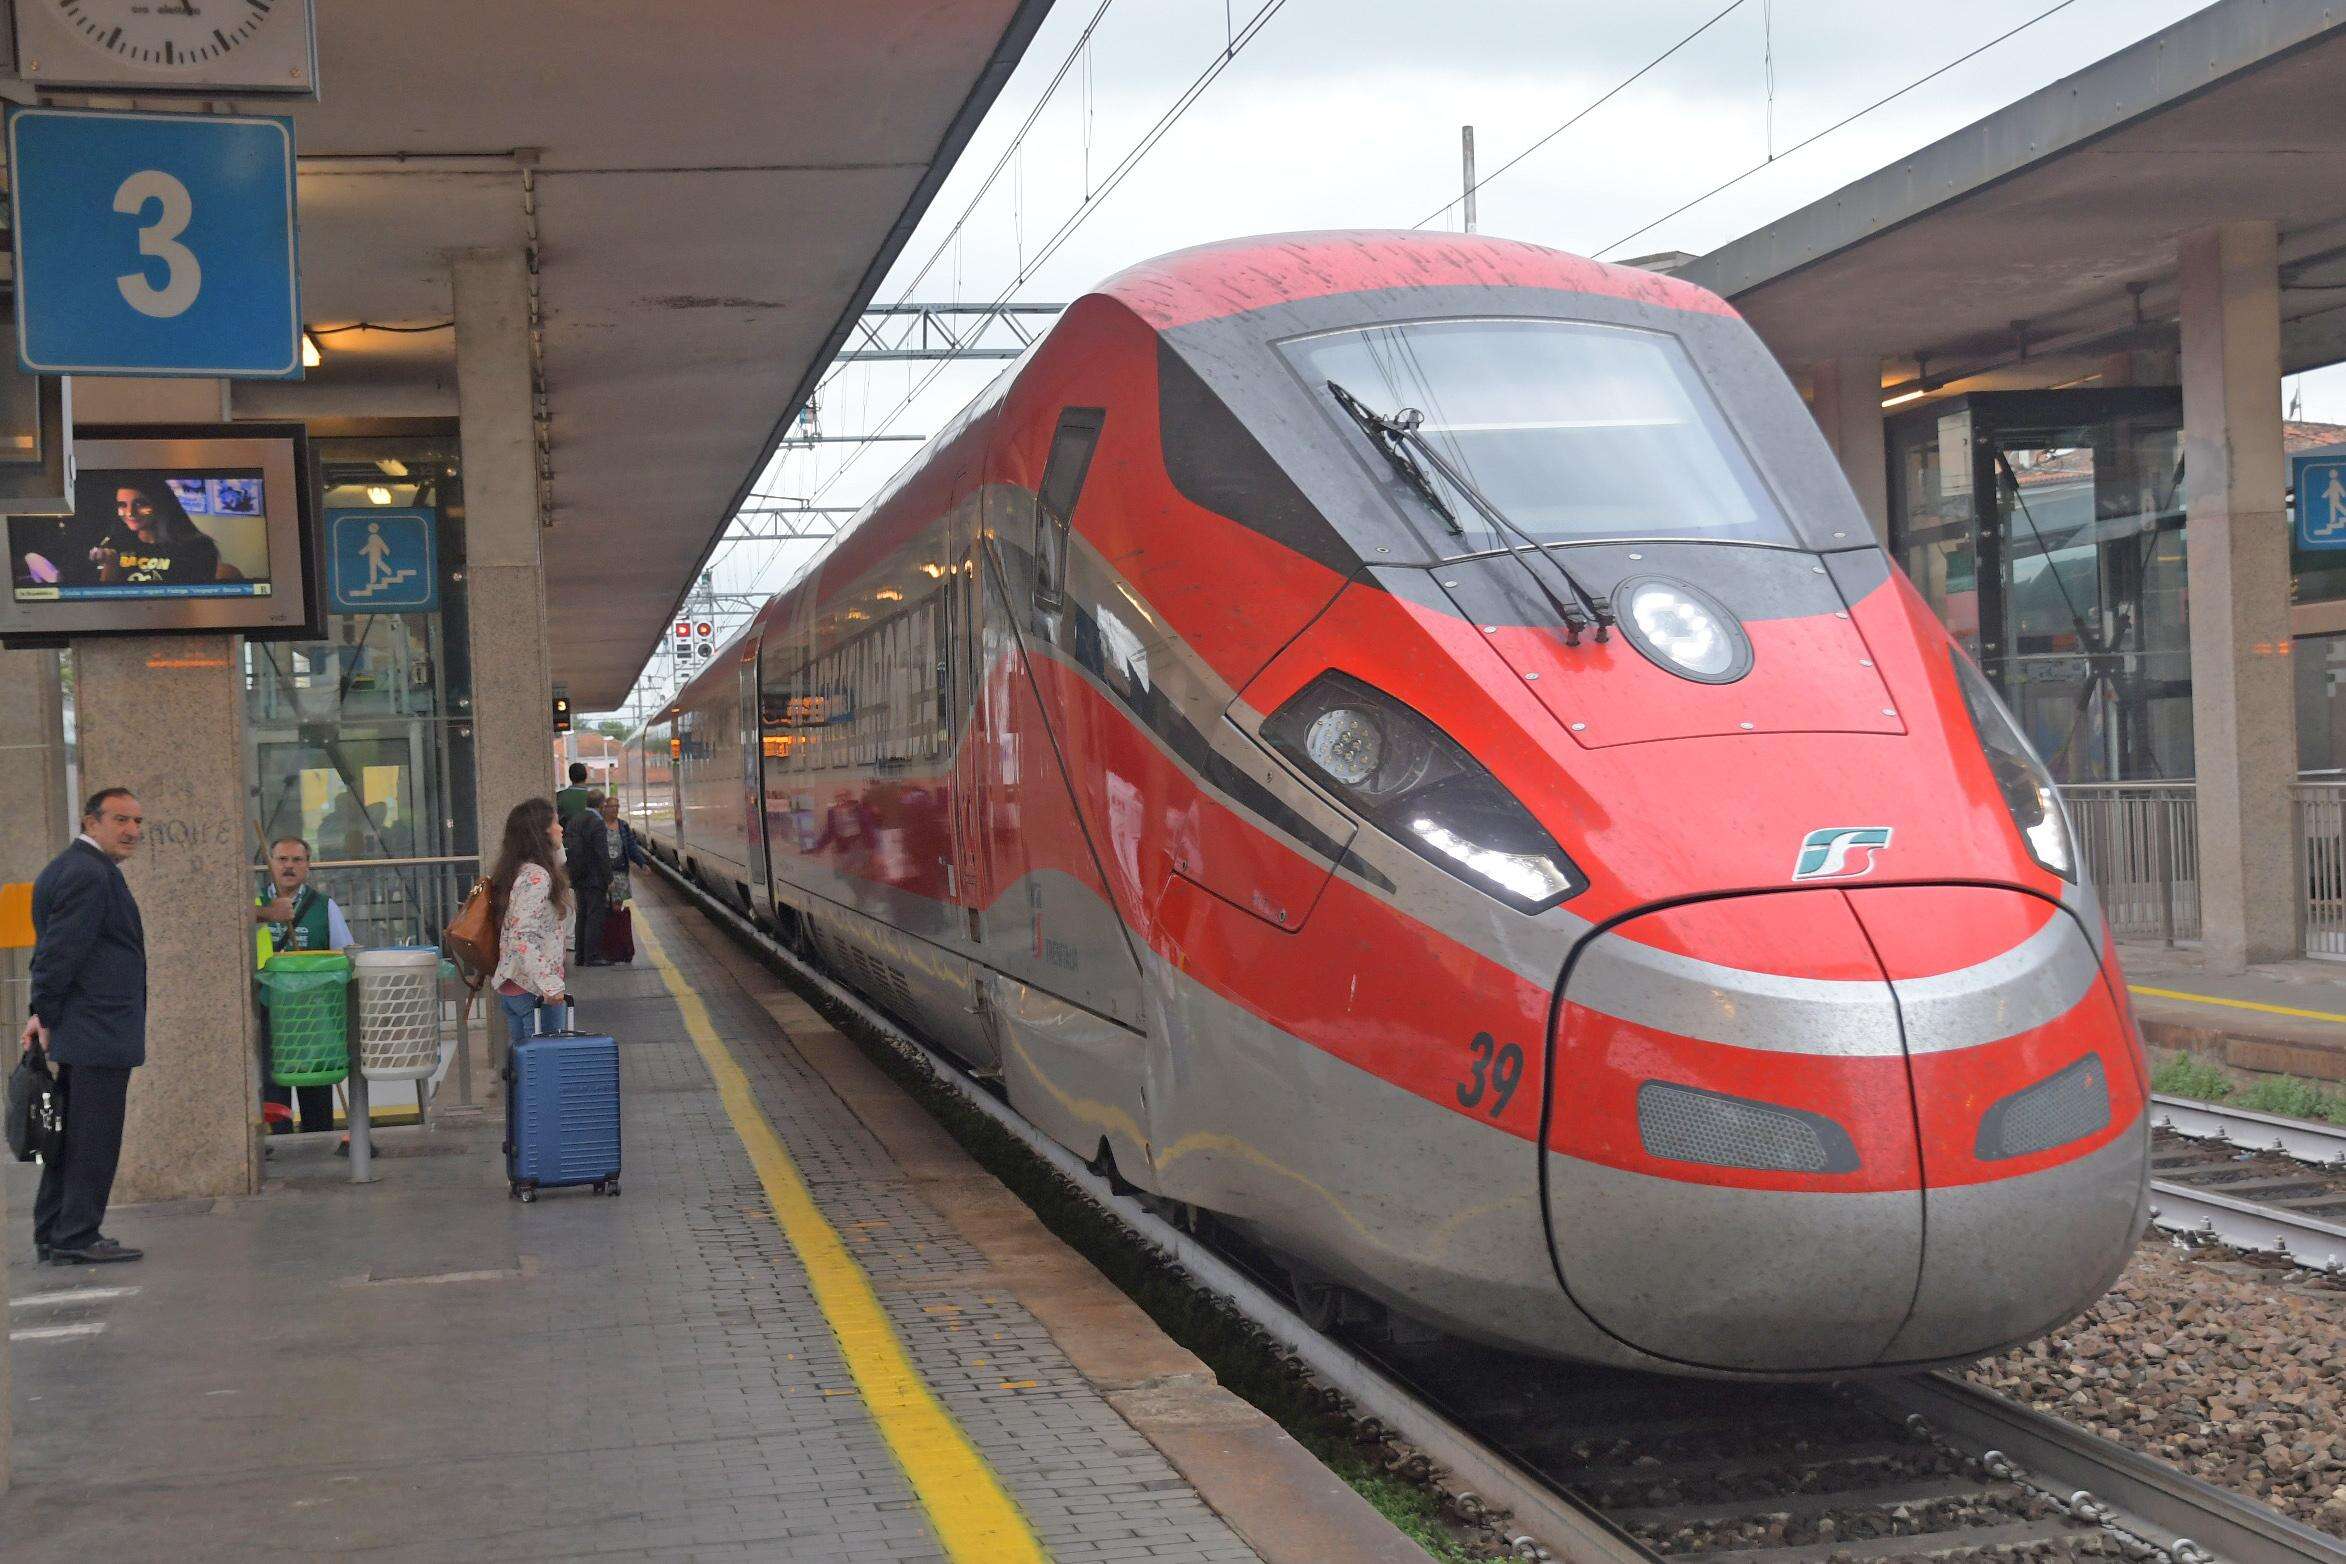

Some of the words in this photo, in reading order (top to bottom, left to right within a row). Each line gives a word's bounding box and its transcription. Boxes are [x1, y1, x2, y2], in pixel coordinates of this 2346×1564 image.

[113, 169, 202, 318] 3
[557, 700, 567, 712] 3
[1455, 1030, 1525, 1118] 39
